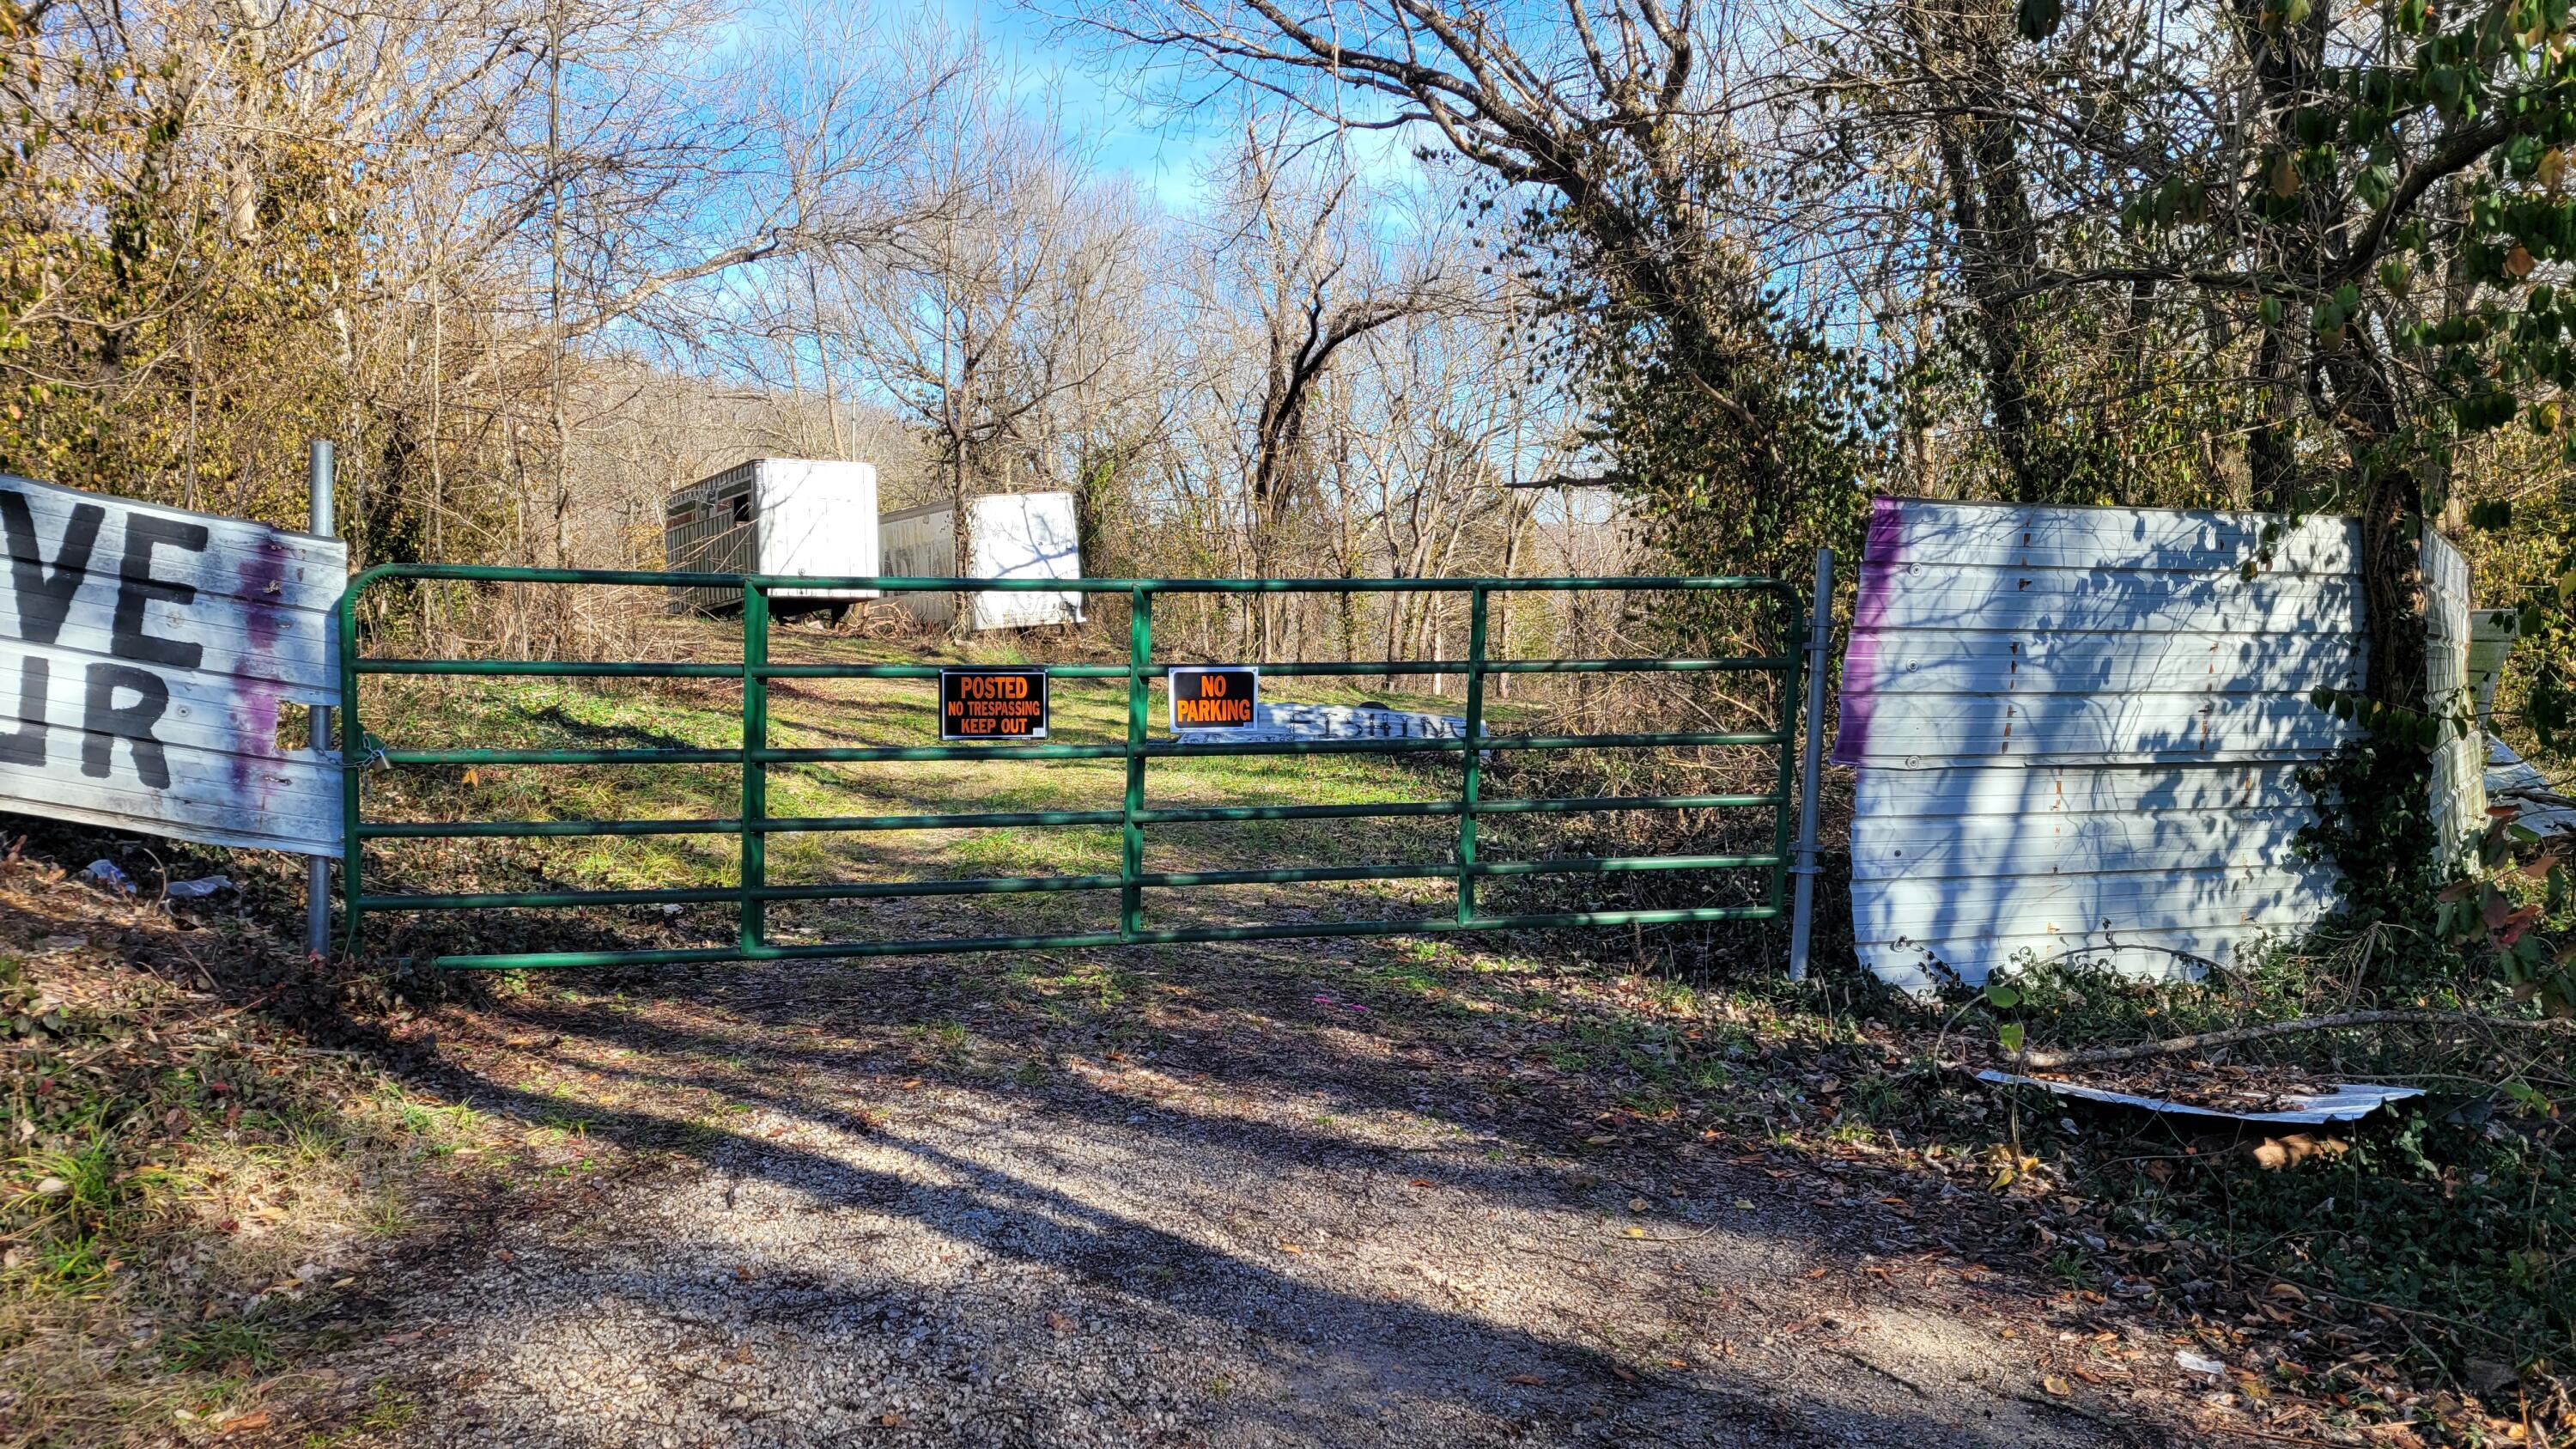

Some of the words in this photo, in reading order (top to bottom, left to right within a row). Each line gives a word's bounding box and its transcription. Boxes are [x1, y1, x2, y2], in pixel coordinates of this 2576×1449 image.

[0, 490, 209, 669] VE
[961, 676, 1029, 699] POSTED
[1201, 674, 1227, 697] NO
[948, 700, 964, 716] NO
[967, 700, 1041, 716] TRESPASSING
[1176, 698, 1251, 722] PARKING
[961, 718, 997, 734] KEEP
[1000, 718, 1028, 734] OUT
